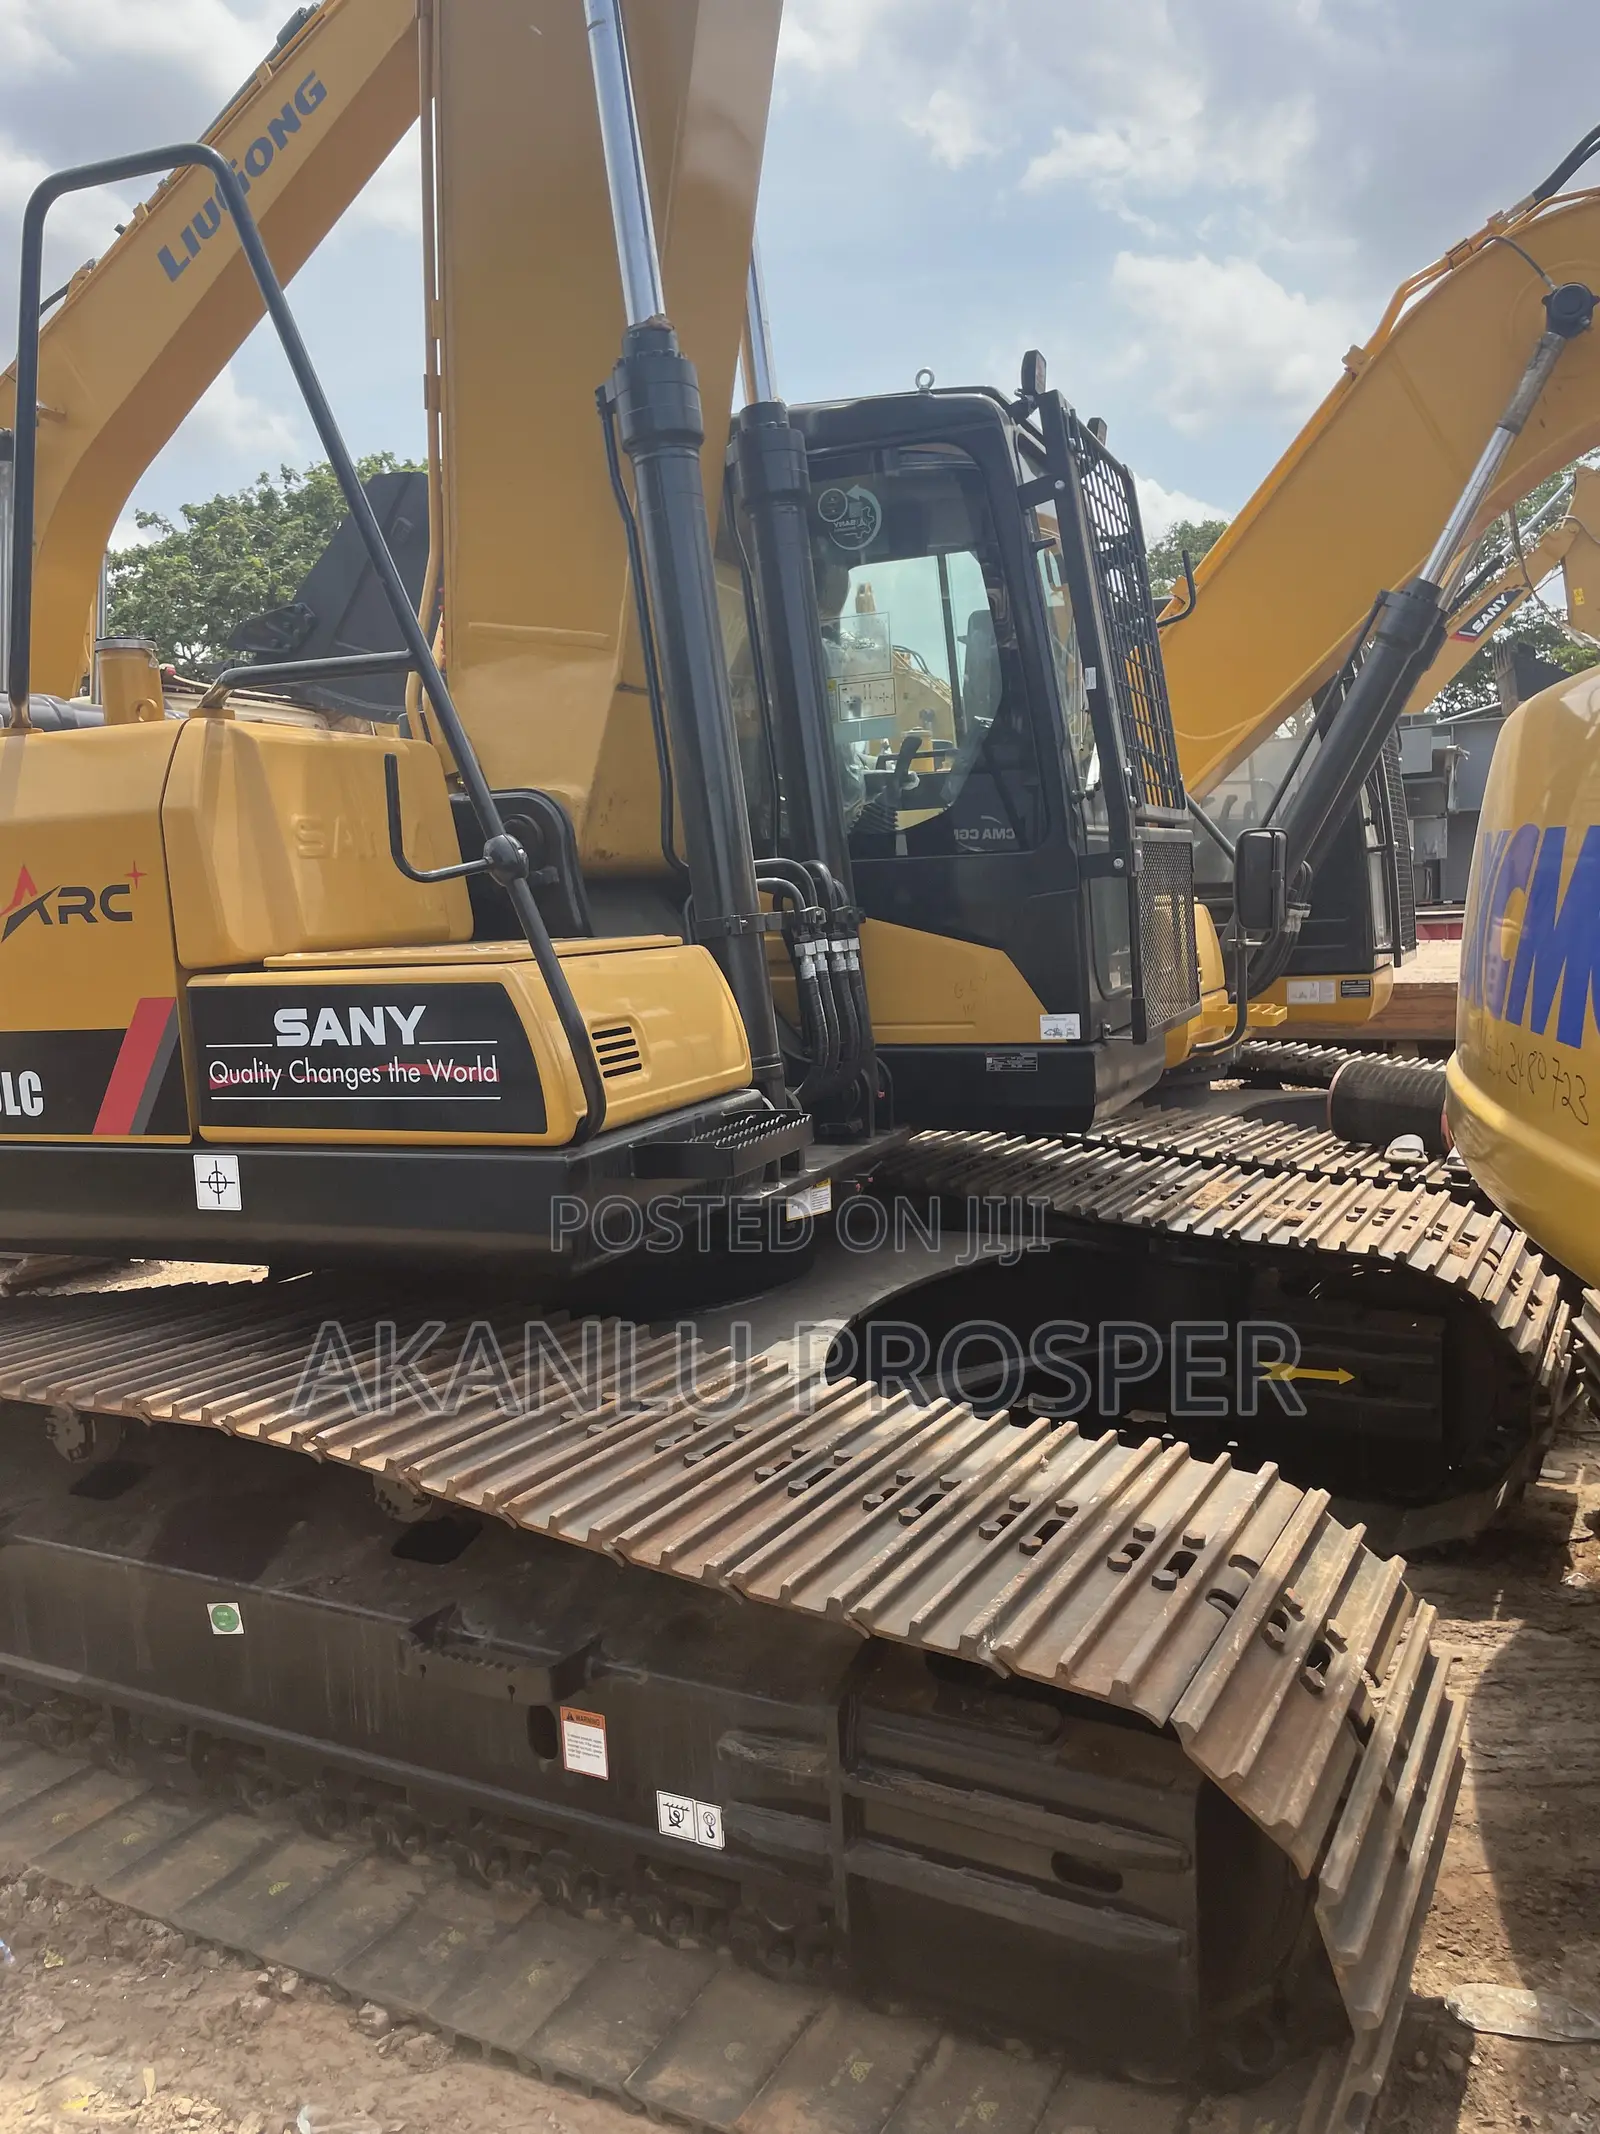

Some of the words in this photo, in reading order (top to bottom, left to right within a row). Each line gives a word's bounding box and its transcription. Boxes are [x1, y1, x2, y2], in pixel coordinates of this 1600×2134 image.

[1472, 594, 1507, 633] SANY
[0, 864, 133, 943] ARC
[1458, 823, 1600, 1050] XCM
[273, 1005, 427, 1047] SANY
[0, 1070, 44, 1117] LC
[208, 1057, 282, 1090] Quality
[288, 1056, 381, 1090] Changes
[388, 1055, 421, 1083] the
[426, 1055, 499, 1083] World
